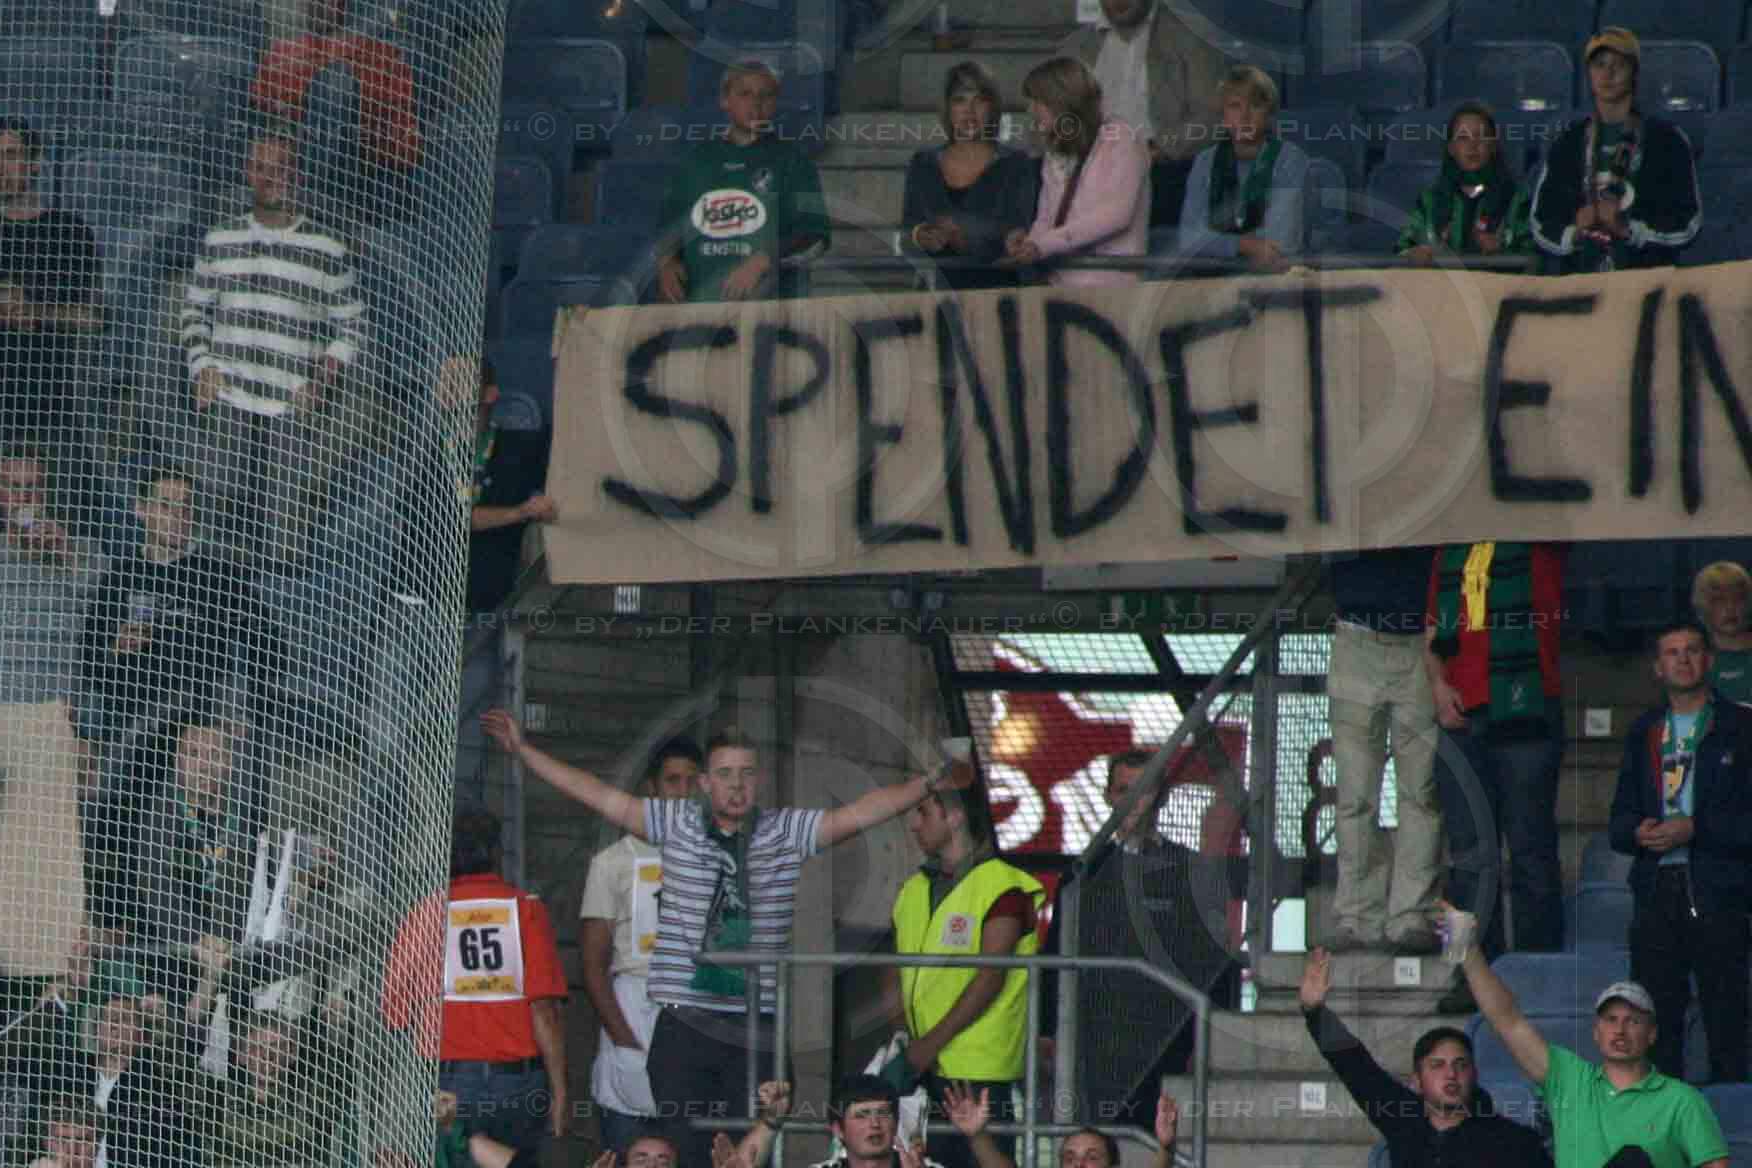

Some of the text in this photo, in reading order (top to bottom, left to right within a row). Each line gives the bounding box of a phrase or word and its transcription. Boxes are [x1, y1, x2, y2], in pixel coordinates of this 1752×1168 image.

[603, 283, 1752, 554] SPENDET EIN
[458, 928, 504, 972] 65
